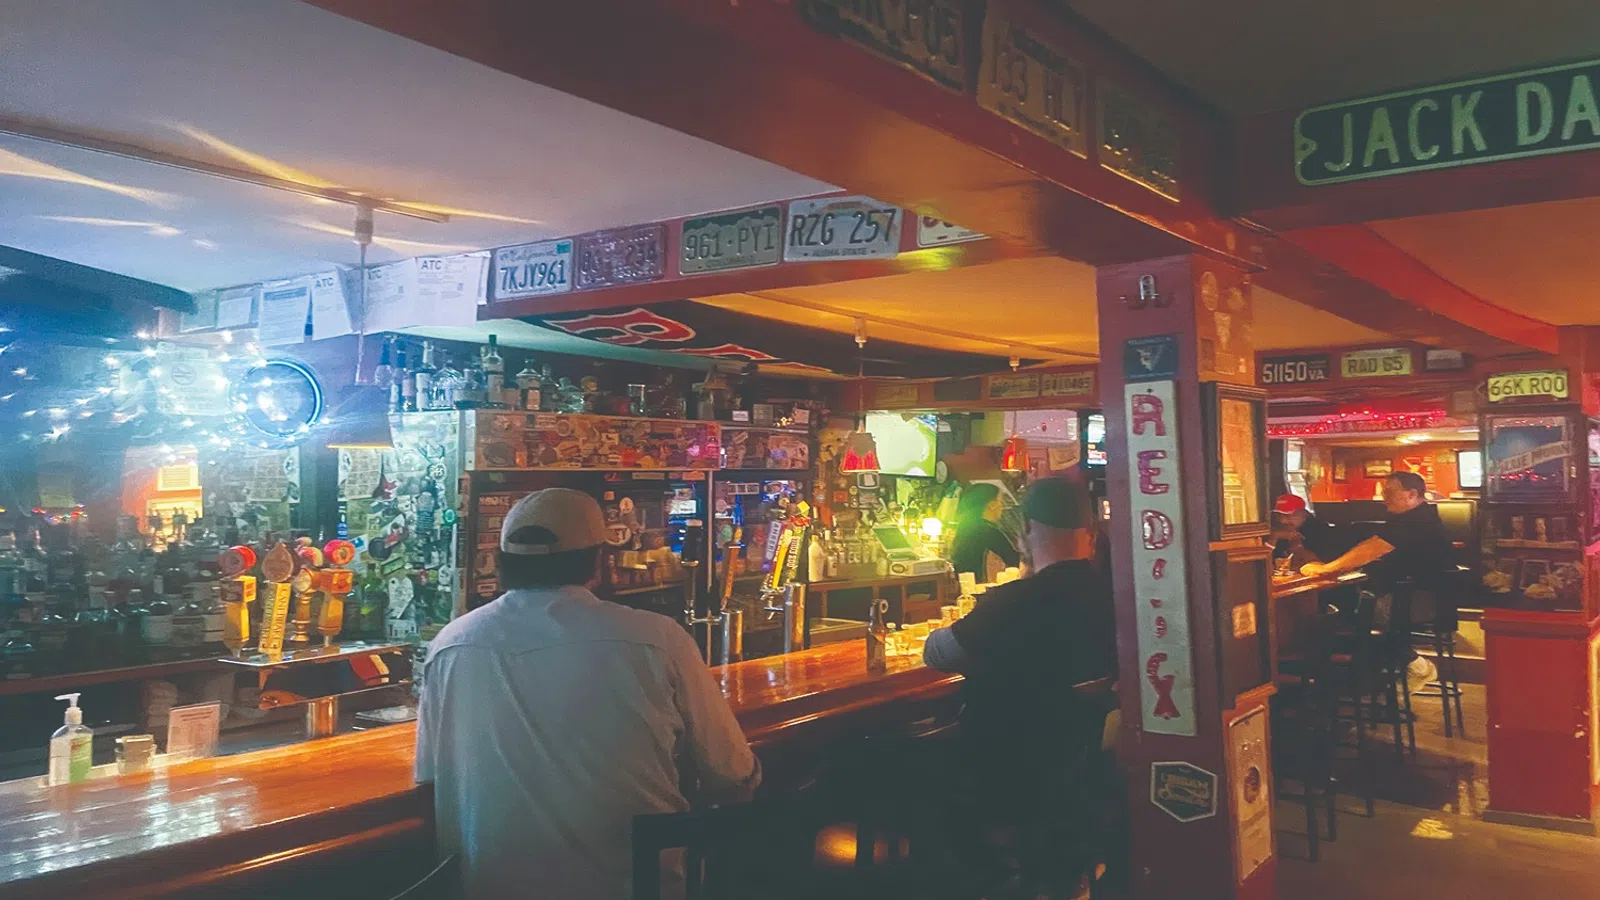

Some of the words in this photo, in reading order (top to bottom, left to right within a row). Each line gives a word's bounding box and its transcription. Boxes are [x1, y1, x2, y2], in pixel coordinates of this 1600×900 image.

[1324, 90, 1487, 172] JACK
[790, 212, 836, 247] RZG
[849, 208, 897, 244] 257
[421, 259, 442, 271] ATC
[314, 276, 334, 290] ATC
[500, 259, 567, 290] 7KJY961
[1308, 369, 1325, 381] VA
[1490, 378, 1525, 396] 66K
